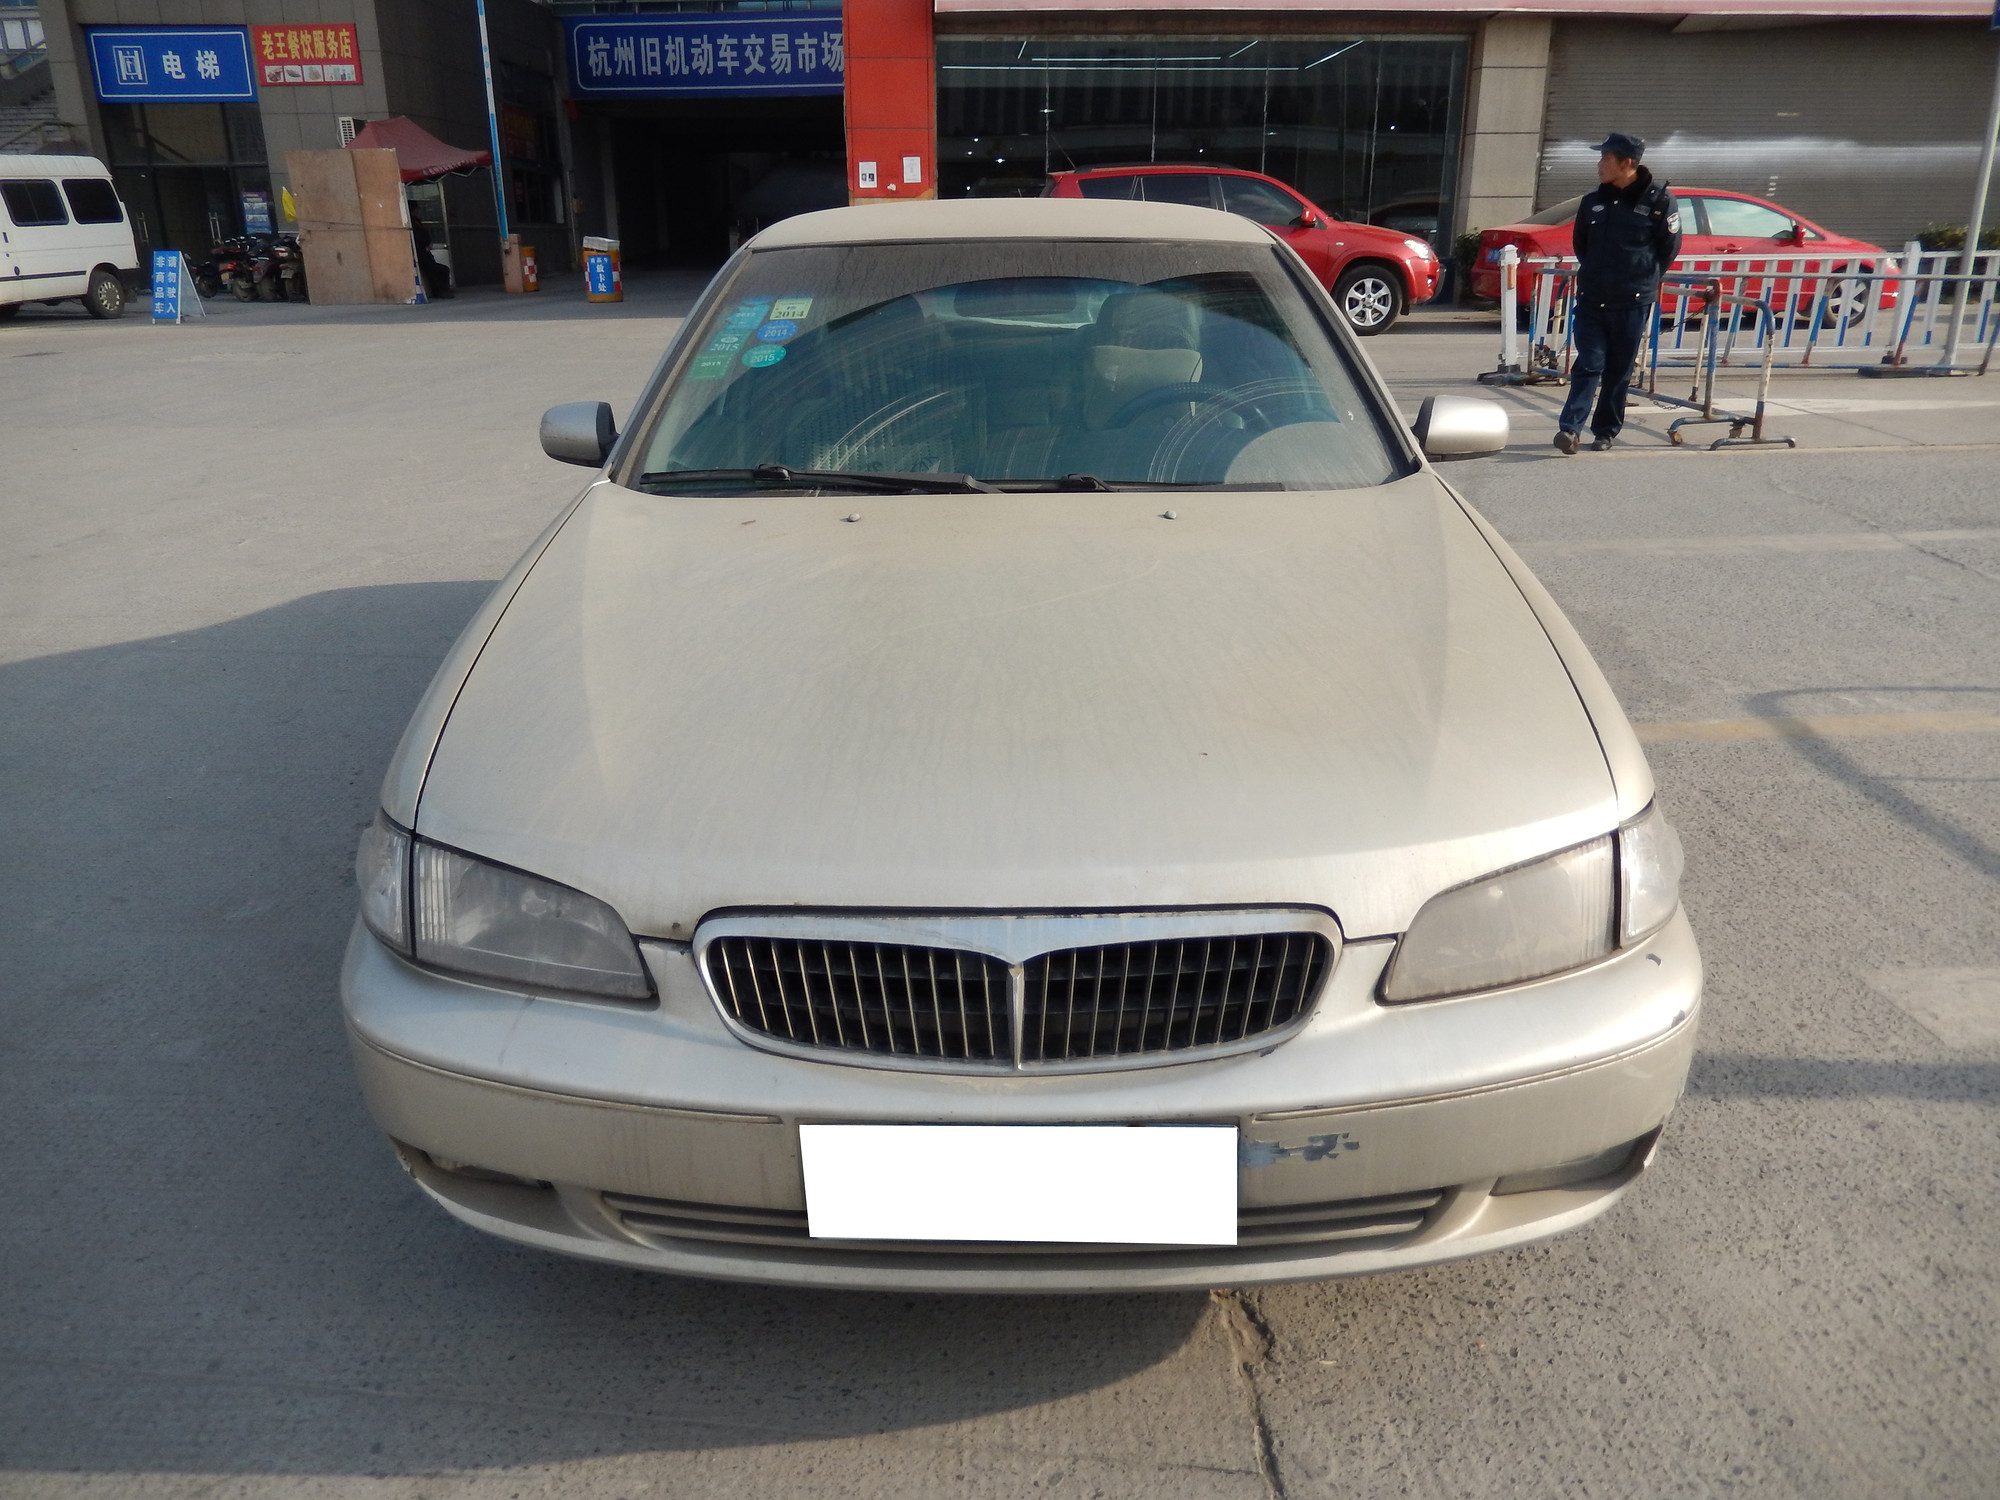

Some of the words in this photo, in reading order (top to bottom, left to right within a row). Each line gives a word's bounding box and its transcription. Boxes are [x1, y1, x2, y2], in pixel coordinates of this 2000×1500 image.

[261, 28, 352, 60] 老王餐饮服务店
[587, 31, 844, 77] 杭州旧机动车交易市场
[162, 50, 220, 80] 电梯
[155, 256, 165, 314] 非商品车
[167, 256, 177, 314] 请勿驶入
[775, 310, 804, 319] 2014
[710, 343, 739, 351] 2015
[752, 354, 775, 362] 2015
